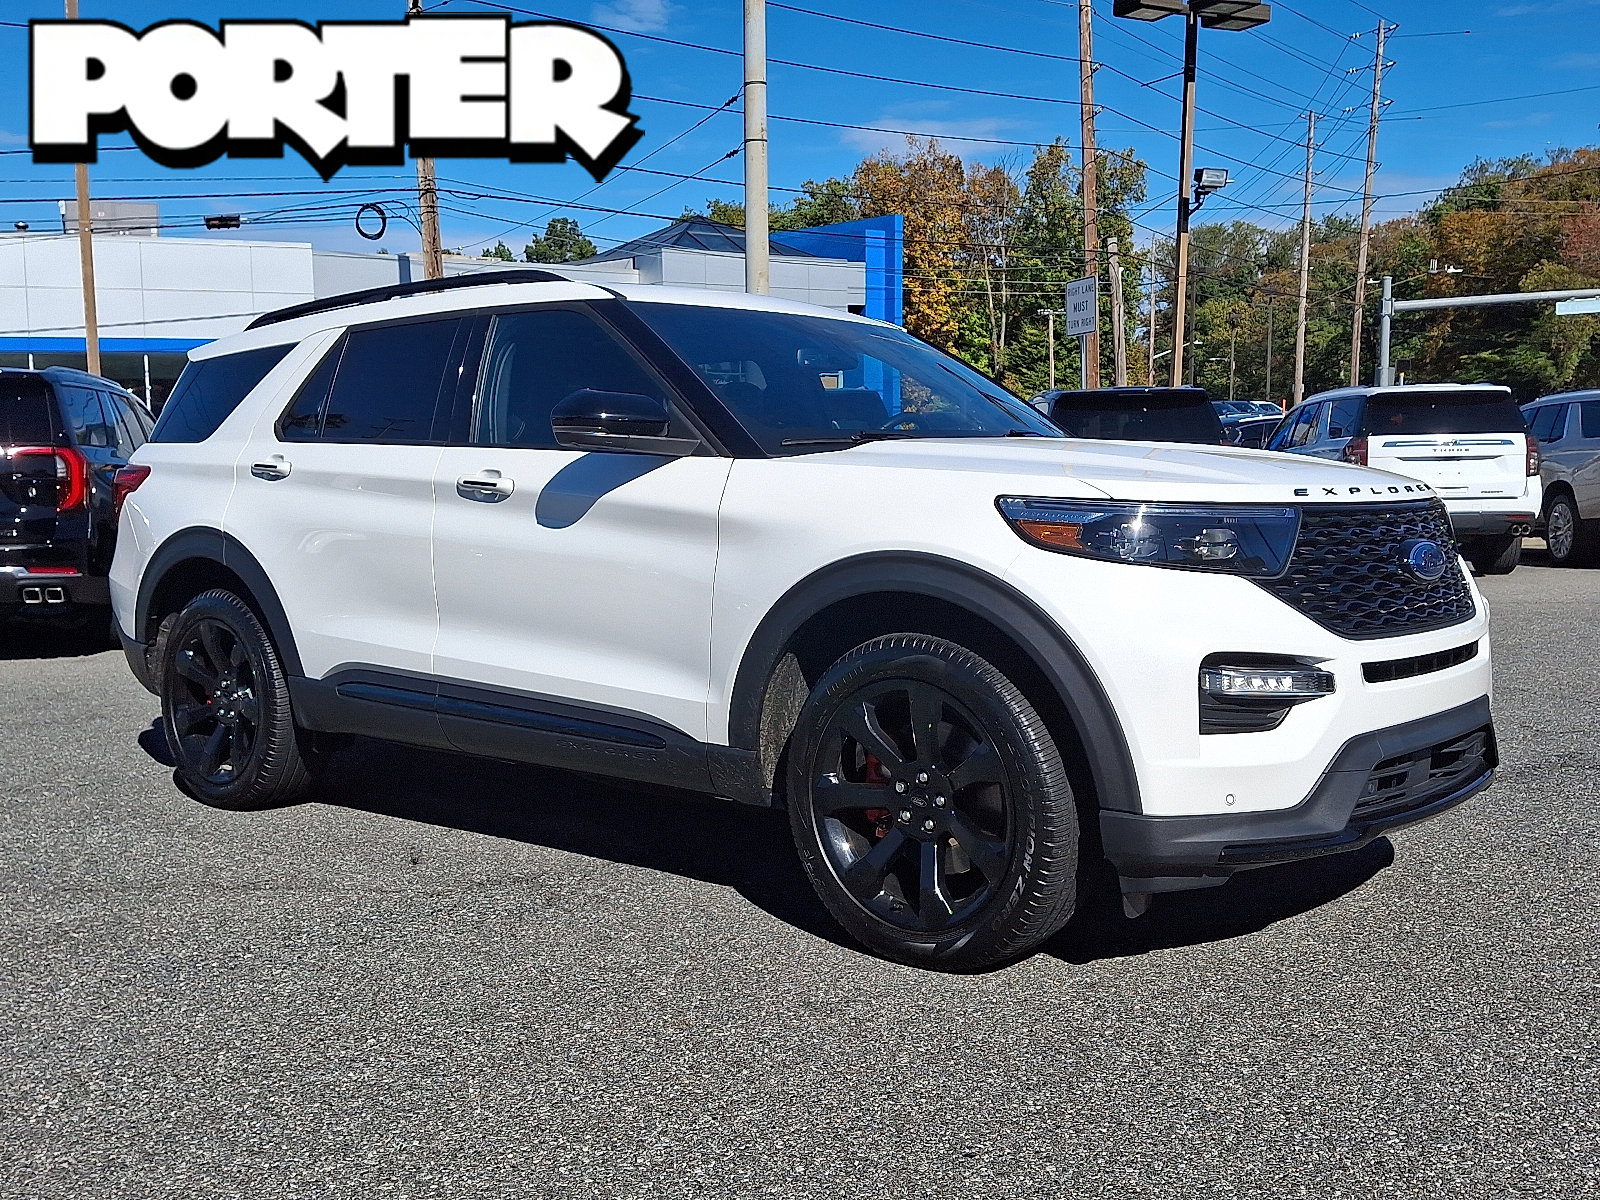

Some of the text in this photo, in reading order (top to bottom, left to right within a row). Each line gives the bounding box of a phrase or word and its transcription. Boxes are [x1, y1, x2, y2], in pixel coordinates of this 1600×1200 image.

[1067, 283, 1095, 298] RIGHT LANE
[1073, 300, 1088, 313] MUST
[1067, 316, 1095, 330] TURN RIGHT
